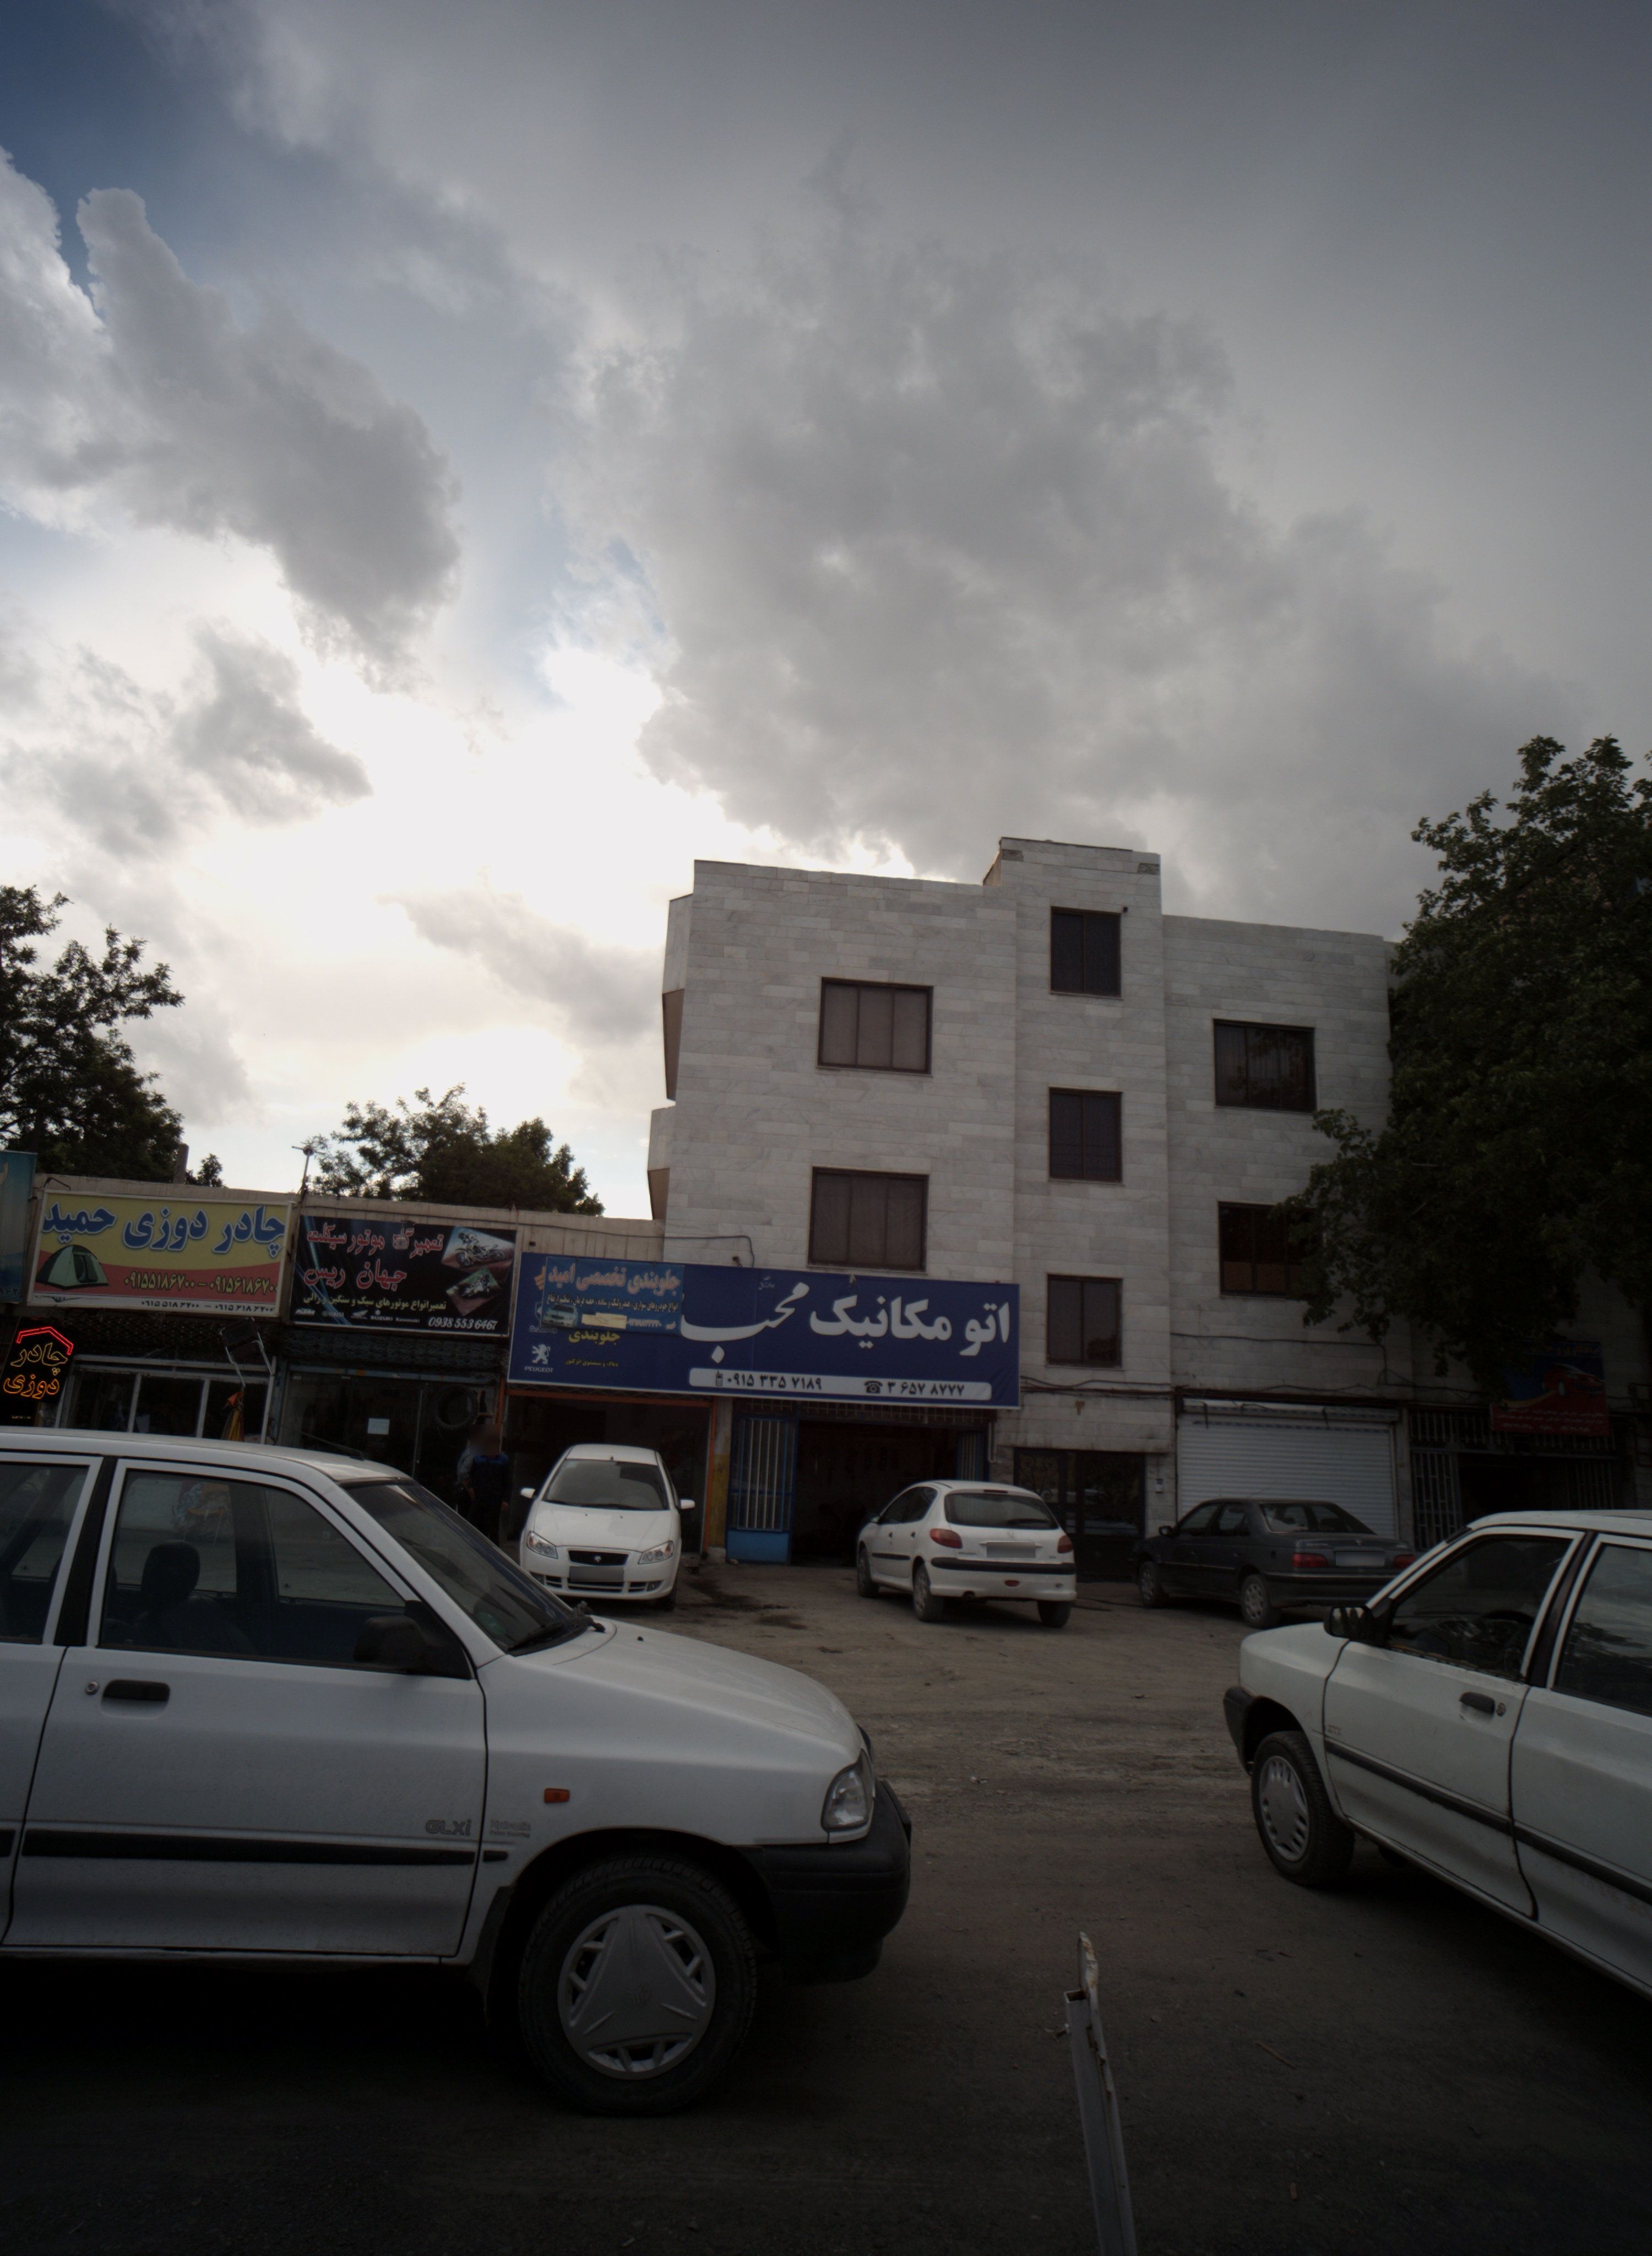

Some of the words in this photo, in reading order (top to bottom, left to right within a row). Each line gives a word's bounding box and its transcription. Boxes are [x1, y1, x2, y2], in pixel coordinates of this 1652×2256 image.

[42, 1202, 117, 1244] حمید
[123, 1207, 208, 1251] دوزی
[213, 1205, 286, 1258] چادر
[306, 1222, 347, 1251] سیکلت
[347, 1230, 385, 1256] موتور
[125, 1270, 195, 1291] ۰۹۱۵۵۱۸۶۷۰۰
[356, 1257, 407, 1292] جهان
[548, 1262, 576, 1289] امید
[627, 1268, 681, 1297] جلوبندی
[428, 1317, 453, 1328] 0938
[454, 1318, 475, 1330] 553
[474, 1319, 498, 1331] 6467
[680, 1282, 811, 1364] محب
[809, 1294, 953, 1350] مکانیک
[959, 1301, 1011, 1357] اتو
[10, 1342, 69, 1376] چادر
[3, 1374, 61, 1400] دوزی
[727, 1373, 754, 1387] ۰۹۱۵
[791, 1376, 822, 1391] ۷۱۸۹
[900, 1381, 926, 1395] ۶۵۷
[930, 1383, 965, 1396] ۸۷۷۷
[425, 1819, 472, 1836] GLXi
